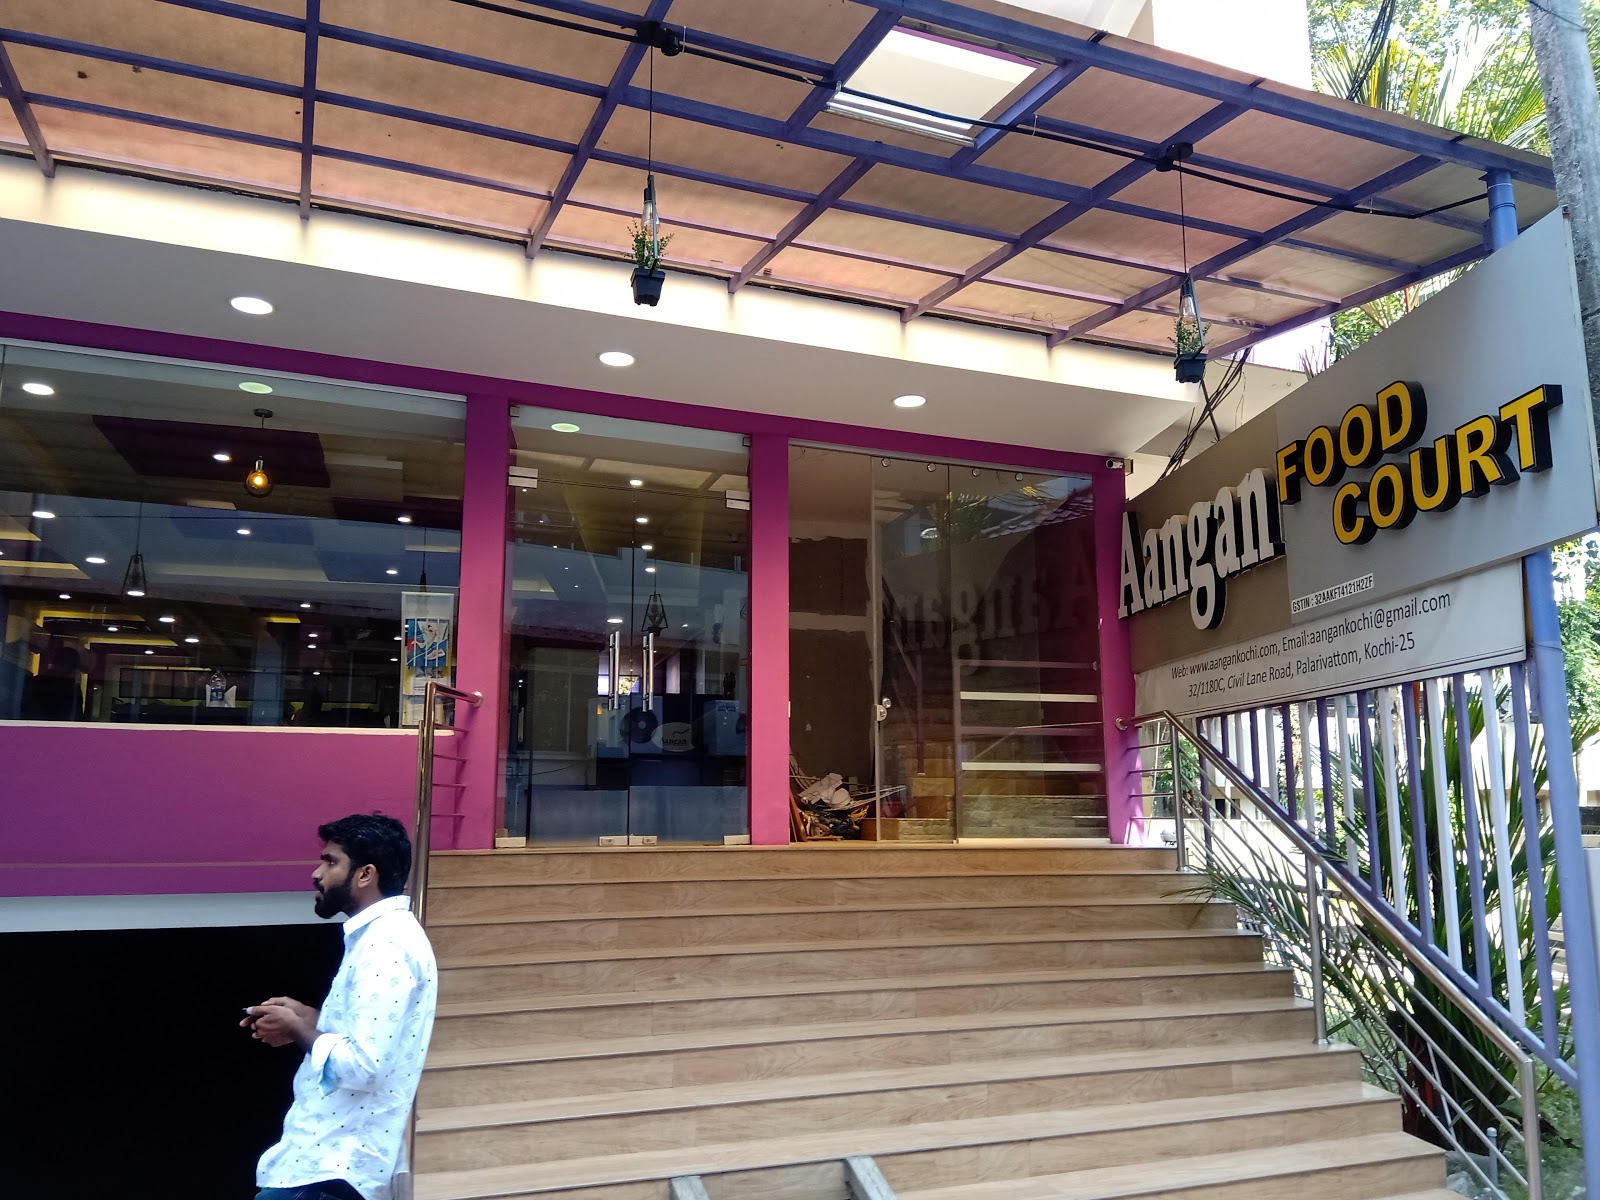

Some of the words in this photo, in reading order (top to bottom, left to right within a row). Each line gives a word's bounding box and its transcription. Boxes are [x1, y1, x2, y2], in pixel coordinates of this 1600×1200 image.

[1276, 380, 1420, 503] FOOD
[1333, 384, 1555, 545] COURT
[1118, 468, 1279, 630] Aangan
[1292, 597, 1310, 613] GSTIN
[1314, 575, 1373, 605] 32AAKFT4121H2ZF
[1171, 664, 1189, 679] Web:
[1189, 642, 1281, 675] www.aangankochi.com,
[1282, 593, 1451, 652] Email:aangankochi@gmail.com
[1188, 677, 1226, 698] 32/1180C,
[1227, 673, 1245, 689] Civil
[1246, 672, 1267, 686] Lane
[1269, 662, 1294, 680] Road,
[1296, 648, 1362, 675] Palarivattom,
[1364, 632, 1415, 660] Kochi-25
